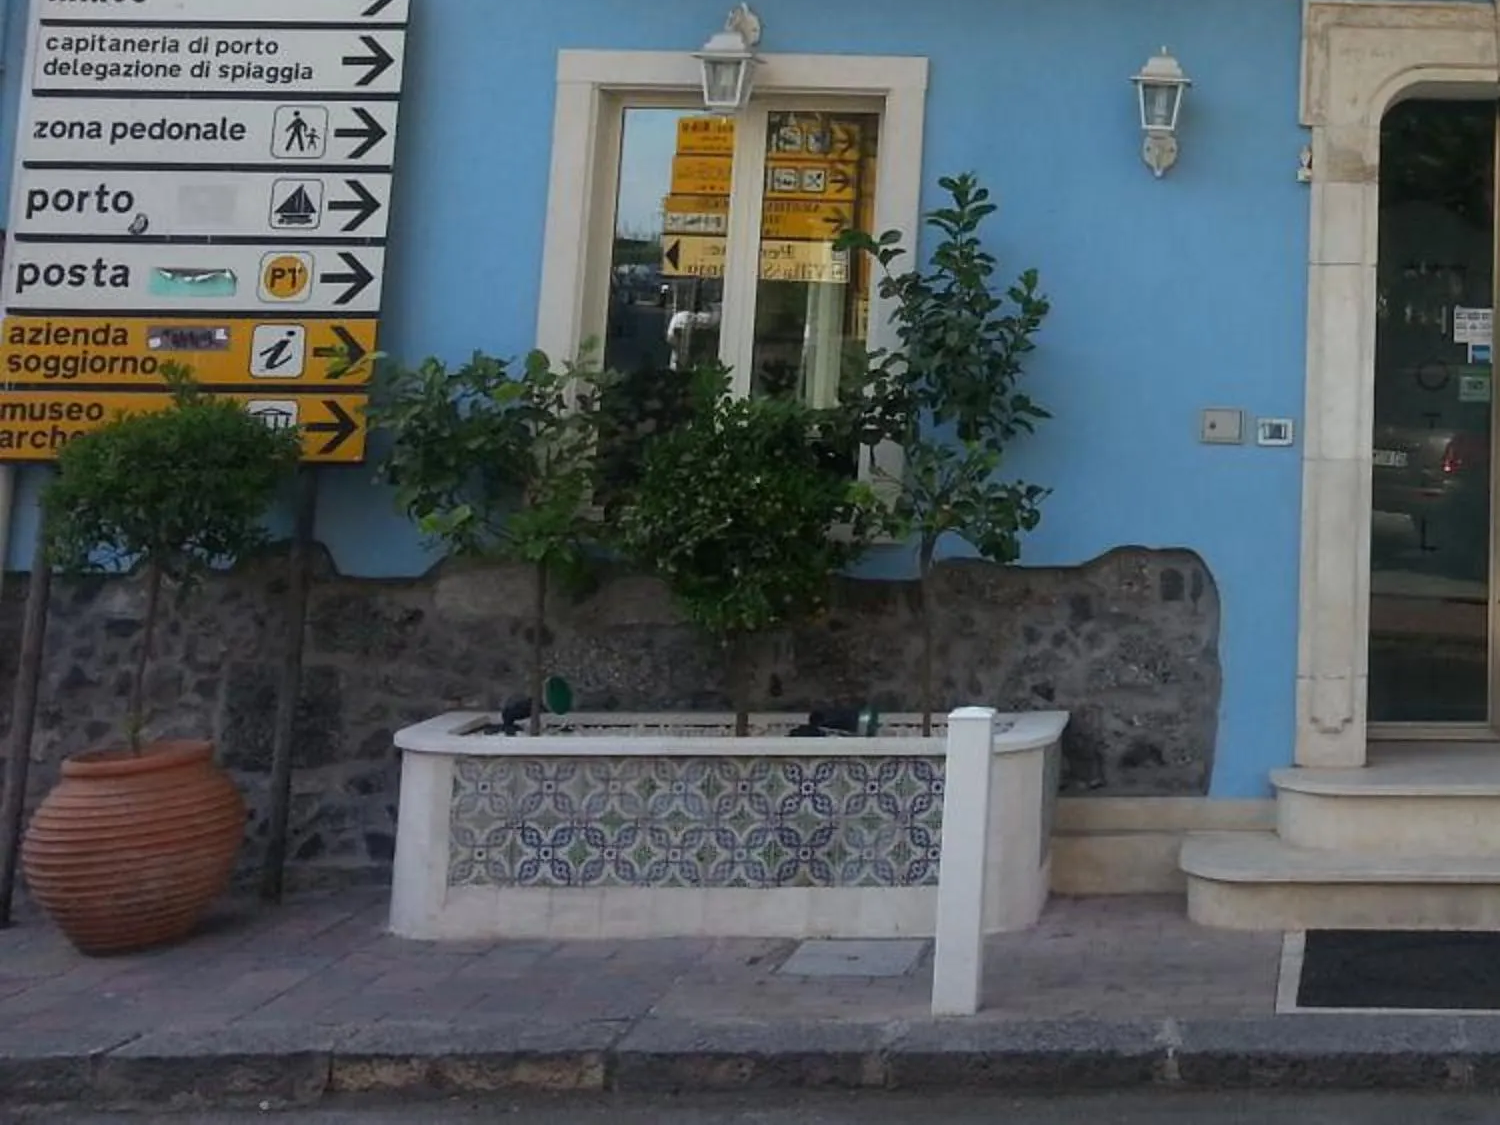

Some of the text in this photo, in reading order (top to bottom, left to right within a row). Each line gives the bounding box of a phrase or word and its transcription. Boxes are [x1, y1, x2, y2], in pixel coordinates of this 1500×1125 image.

[45, 34, 279, 57] capitaneria di porto
[43, 58, 314, 84] delegazione di spiaggia
[33, 116, 247, 145] zona pedonale
[26, 184, 135, 219] porto
[16, 257, 131, 294] posta
[8, 322, 129, 347] azienda
[7, 350, 158, 379] soggiorno
[0, 401, 104, 422] museo
